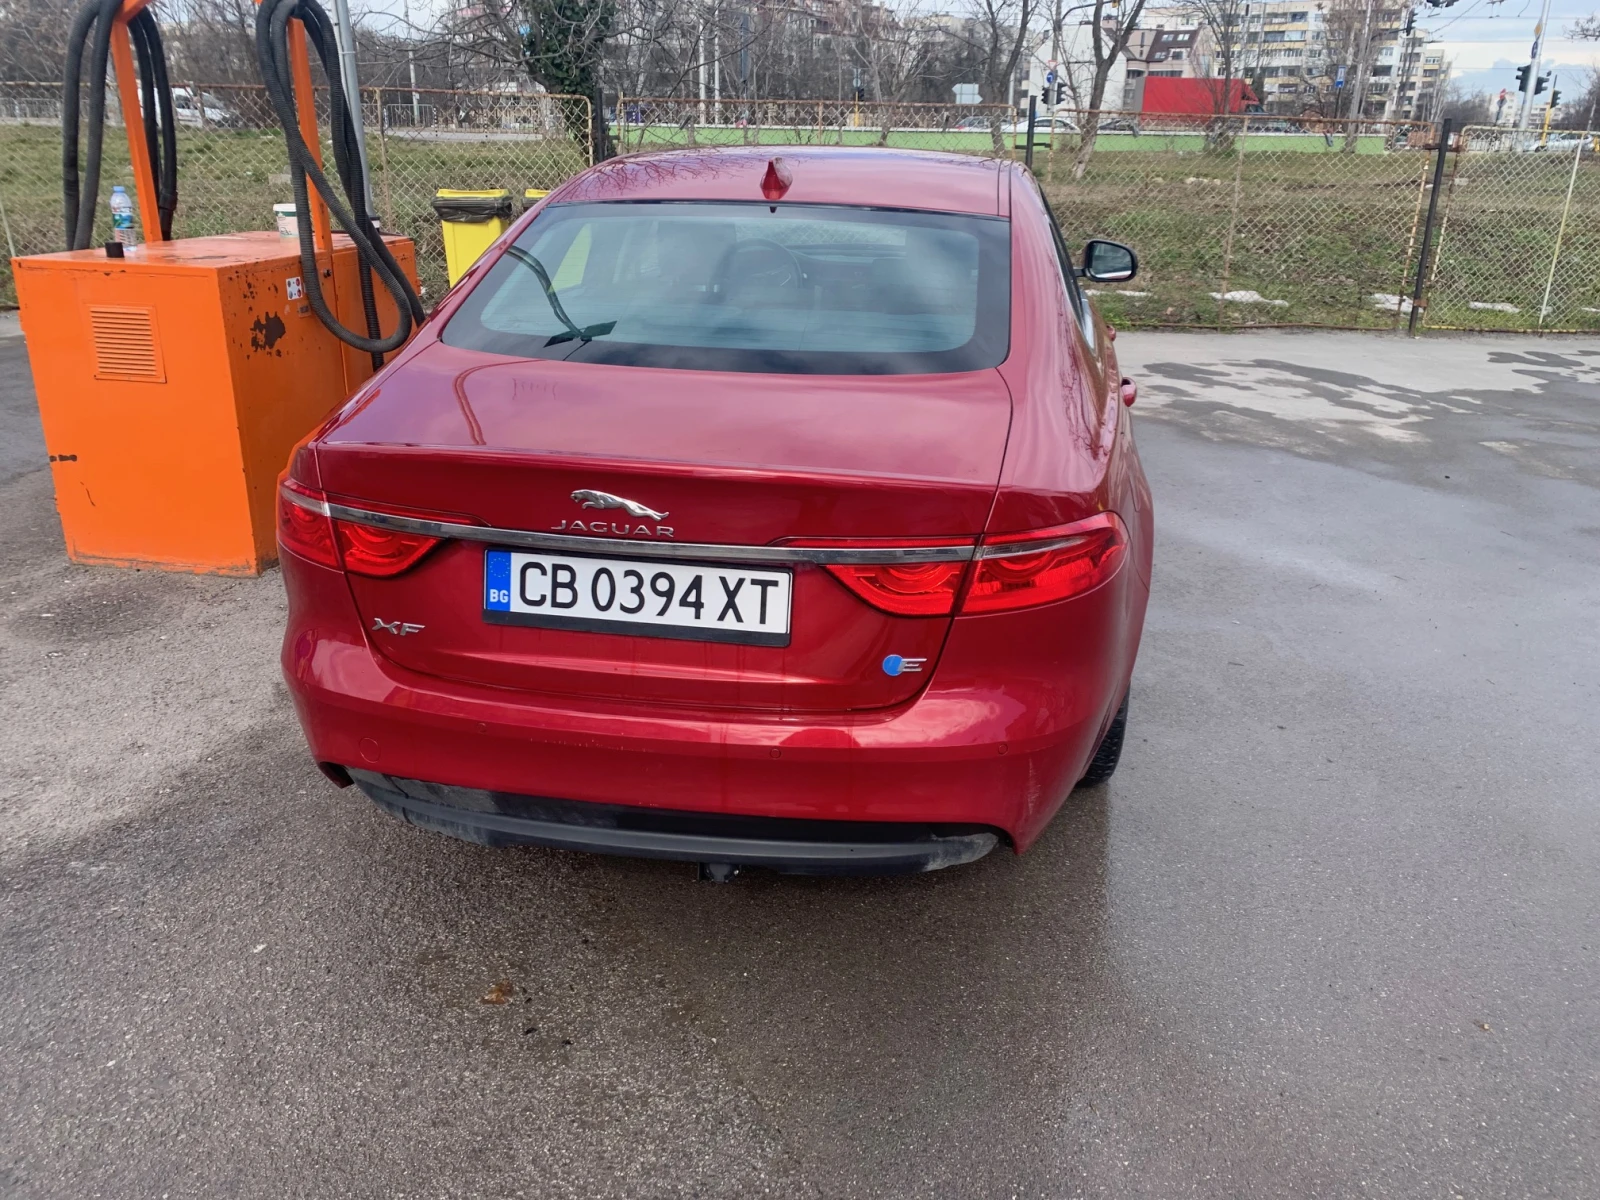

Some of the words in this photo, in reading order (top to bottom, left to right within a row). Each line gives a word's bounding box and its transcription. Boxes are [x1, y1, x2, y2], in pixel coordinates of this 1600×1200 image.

[551, 520, 674, 537] JAGUAR
[489, 589, 509, 603] BG
[520, 561, 578, 609] CB
[591, 567, 704, 620] 0394
[717, 575, 779, 625] XT
[372, 617, 425, 636] XF
